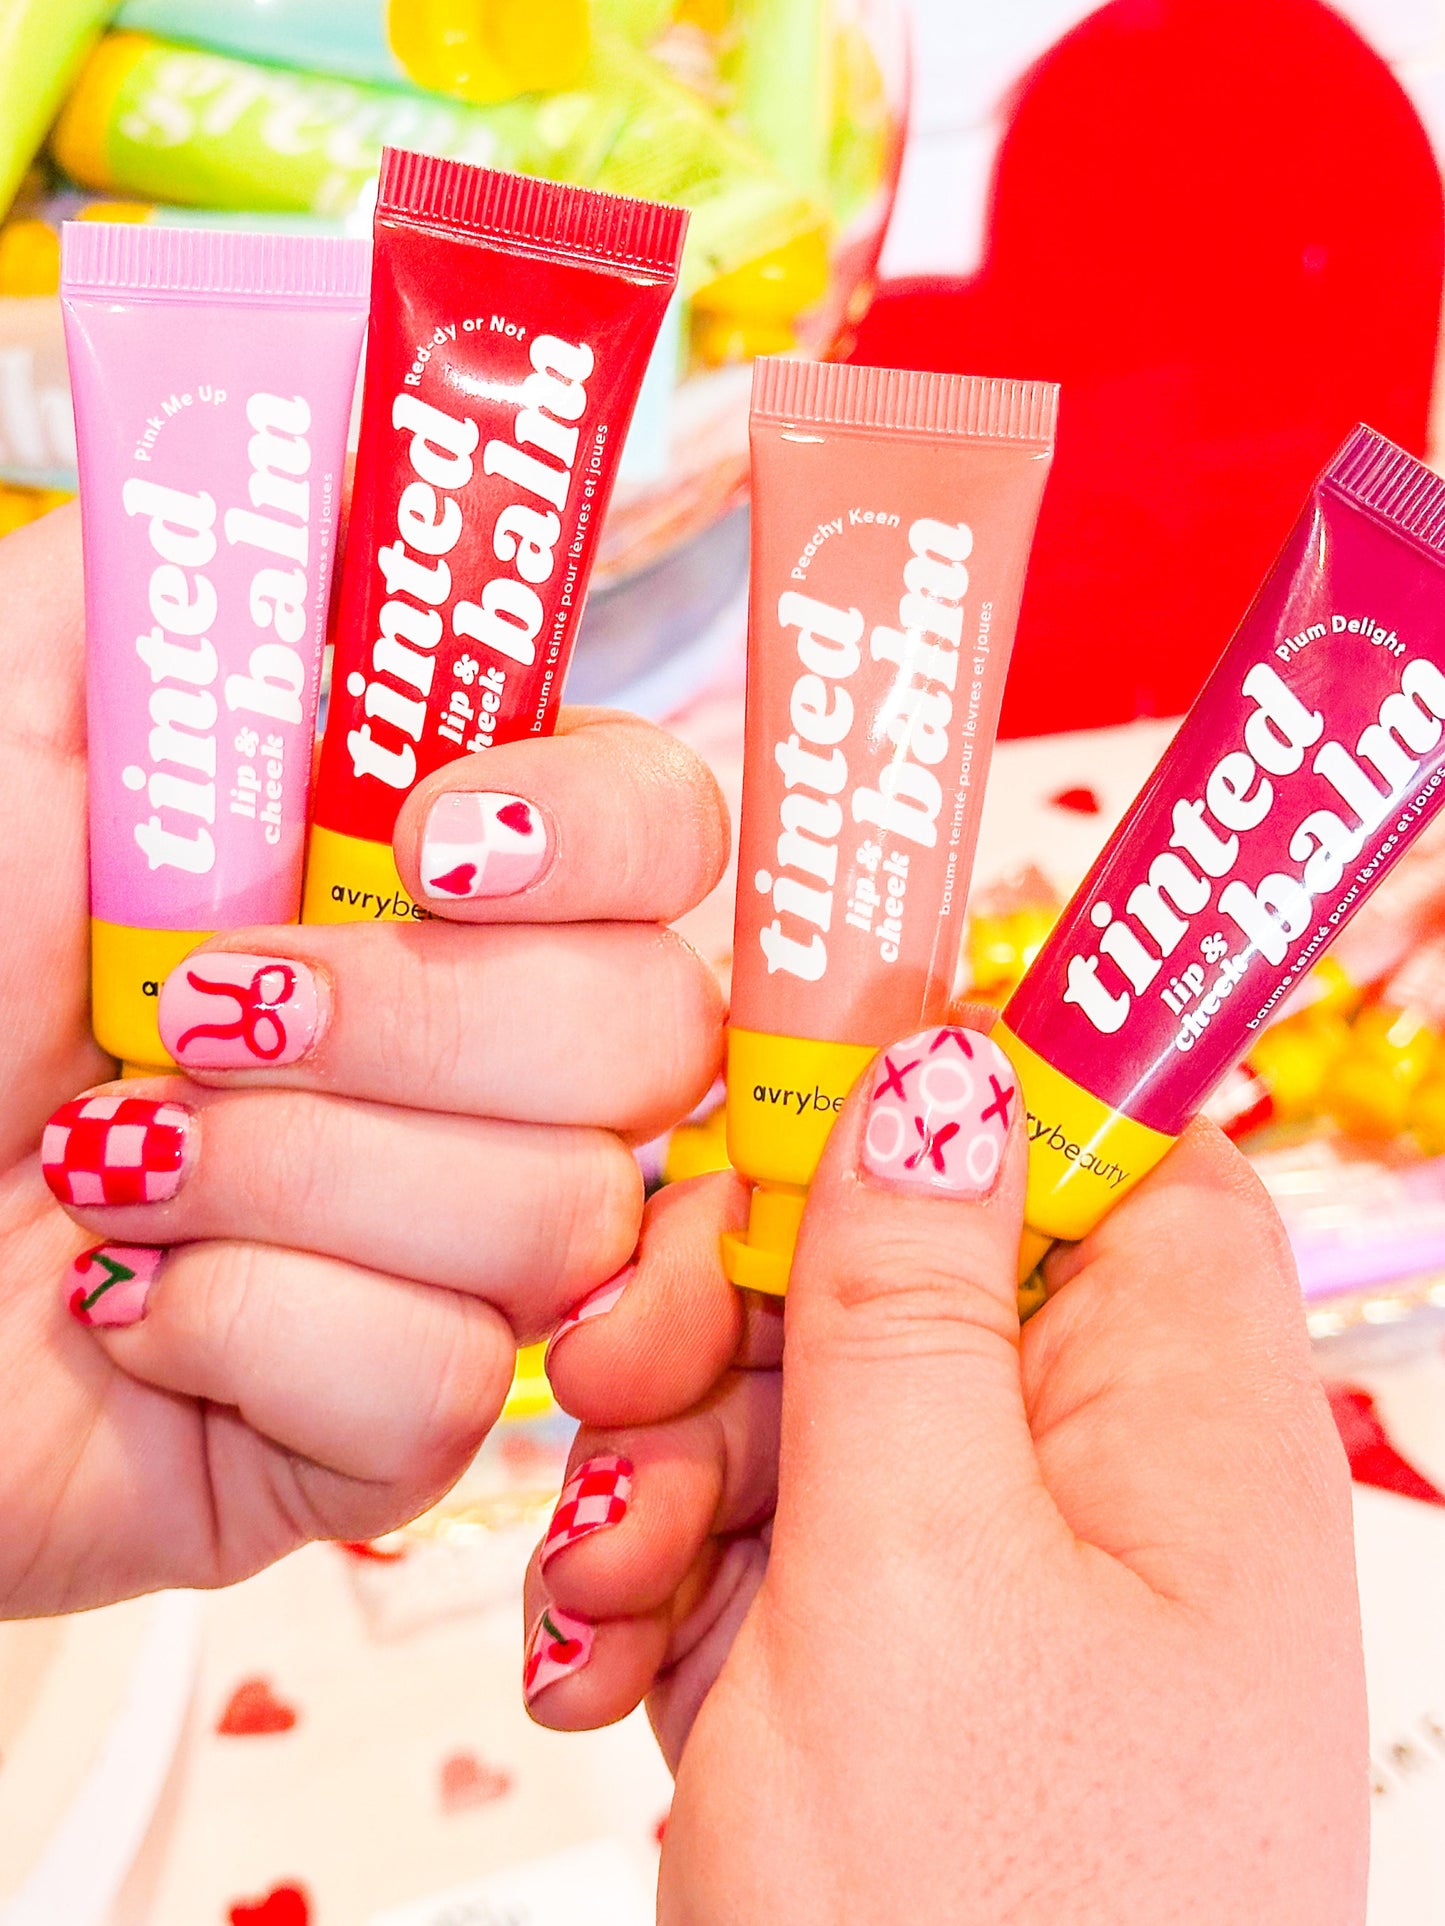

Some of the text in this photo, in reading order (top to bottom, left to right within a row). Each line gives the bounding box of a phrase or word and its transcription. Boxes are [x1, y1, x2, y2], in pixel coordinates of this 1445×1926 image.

[404, 315, 526, 386] Red-dy or Not
[134, 384, 227, 462] Pink Me Up
[320, 472, 333, 524] joues
[320, 529, 330, 547] et
[452, 334, 594, 666] balm
[791, 507, 901, 580] Peachy Keen
[224, 392, 311, 725] balm
[346, 393, 479, 789] tinted
[530, 424, 608, 732] baume teinté pour lèvres et joues
[122, 478, 218, 874] tinted
[852, 518, 973, 848] balm
[1275, 614, 1407, 662] Plum Delight
[438, 653, 479, 746] lip &
[466, 667, 506, 753] heek
[230, 726, 263, 819] lip &
[260, 734, 284, 845] cheek
[754, 591, 865, 981] tinted
[938, 601, 994, 916] baume teinté pour lèvres et joues
[1063, 662, 1325, 1034] tinted
[1218, 658, 1445, 966] balm
[331, 884, 432, 920] avrybe
[845, 839, 883, 932] lip &
[875, 850, 910, 963] cheek
[1246, 766, 1445, 1031] baume teinté pour lèvres et joues
[1160, 931, 1228, 1016] lip &
[1175, 954, 1249, 1052] cheek
[753, 1085, 845, 1116] avrybe
[1026, 1111, 1131, 1189] rybeauty
